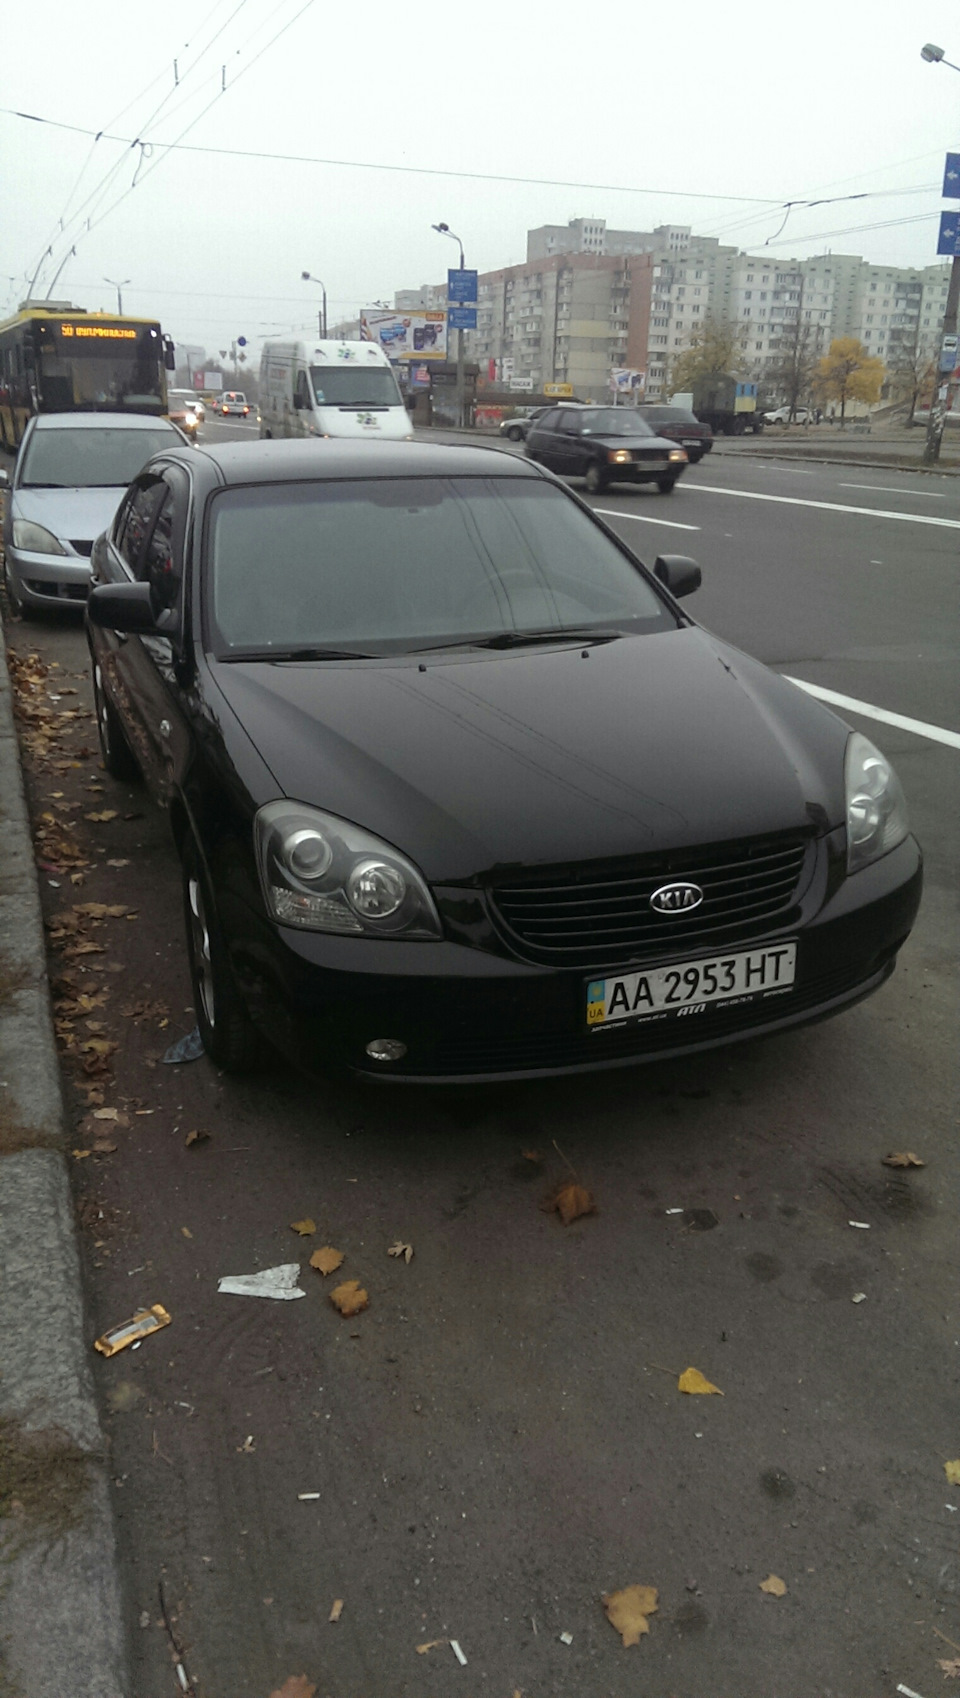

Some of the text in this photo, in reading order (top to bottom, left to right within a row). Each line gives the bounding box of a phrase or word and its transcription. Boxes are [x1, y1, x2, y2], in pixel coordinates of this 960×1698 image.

[659, 889, 695, 908] KIA
[607, 949, 790, 1015] AA 2953 HT
[588, 1008, 604, 1020] UA
